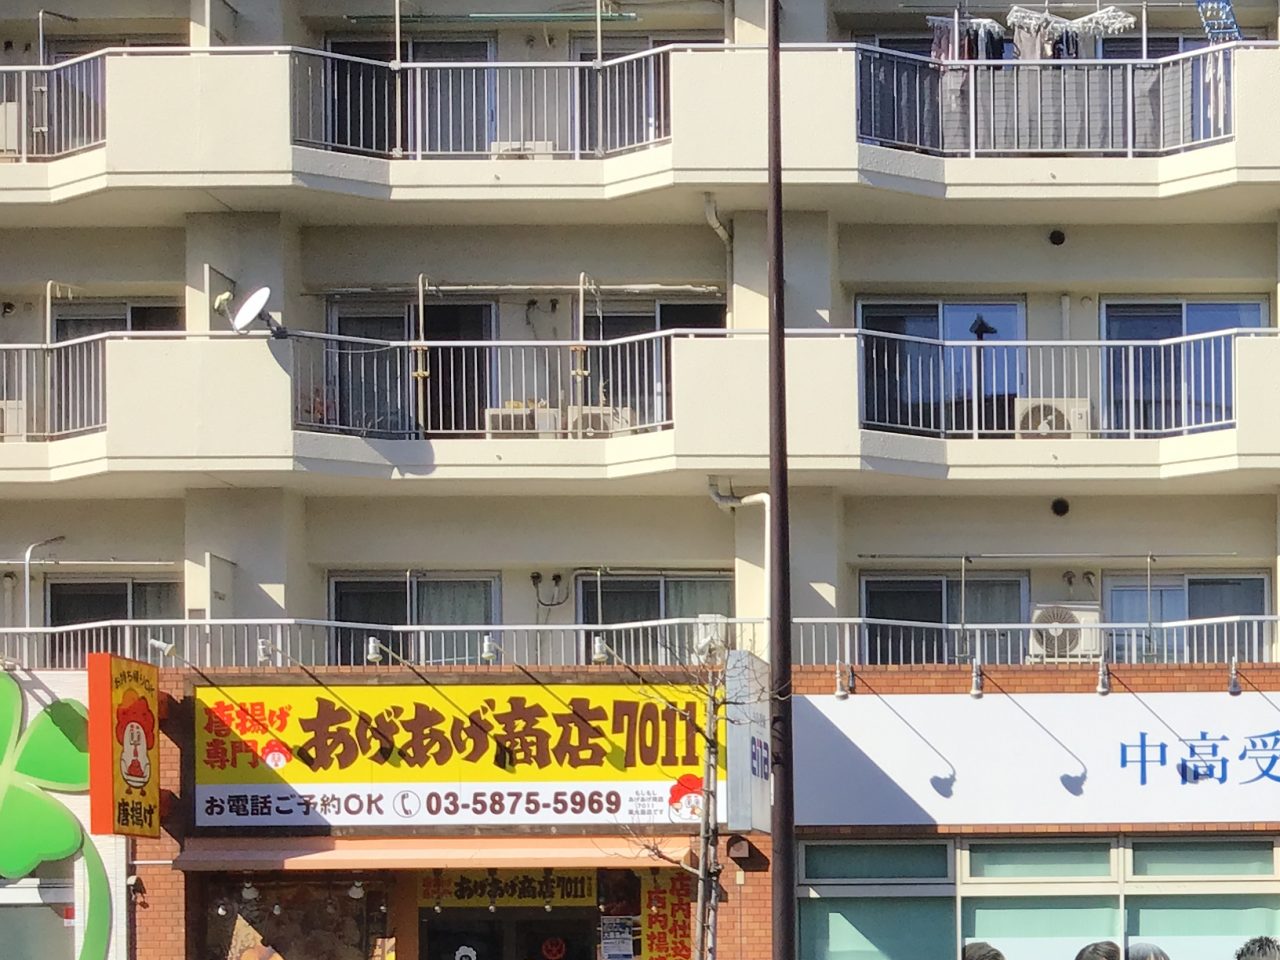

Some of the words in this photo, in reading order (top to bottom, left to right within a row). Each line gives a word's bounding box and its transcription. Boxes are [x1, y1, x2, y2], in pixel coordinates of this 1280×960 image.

[203, 701, 291, 735] 唐揚げ
[299, 696, 699, 772] あげあげ商店7011
[203, 739, 260, 769] 専門
[117, 799, 157, 828] 唐揚げ
[204, 794, 384, 817] お電話ご予約OK
[426, 791, 621, 816] 03-5875-5969
